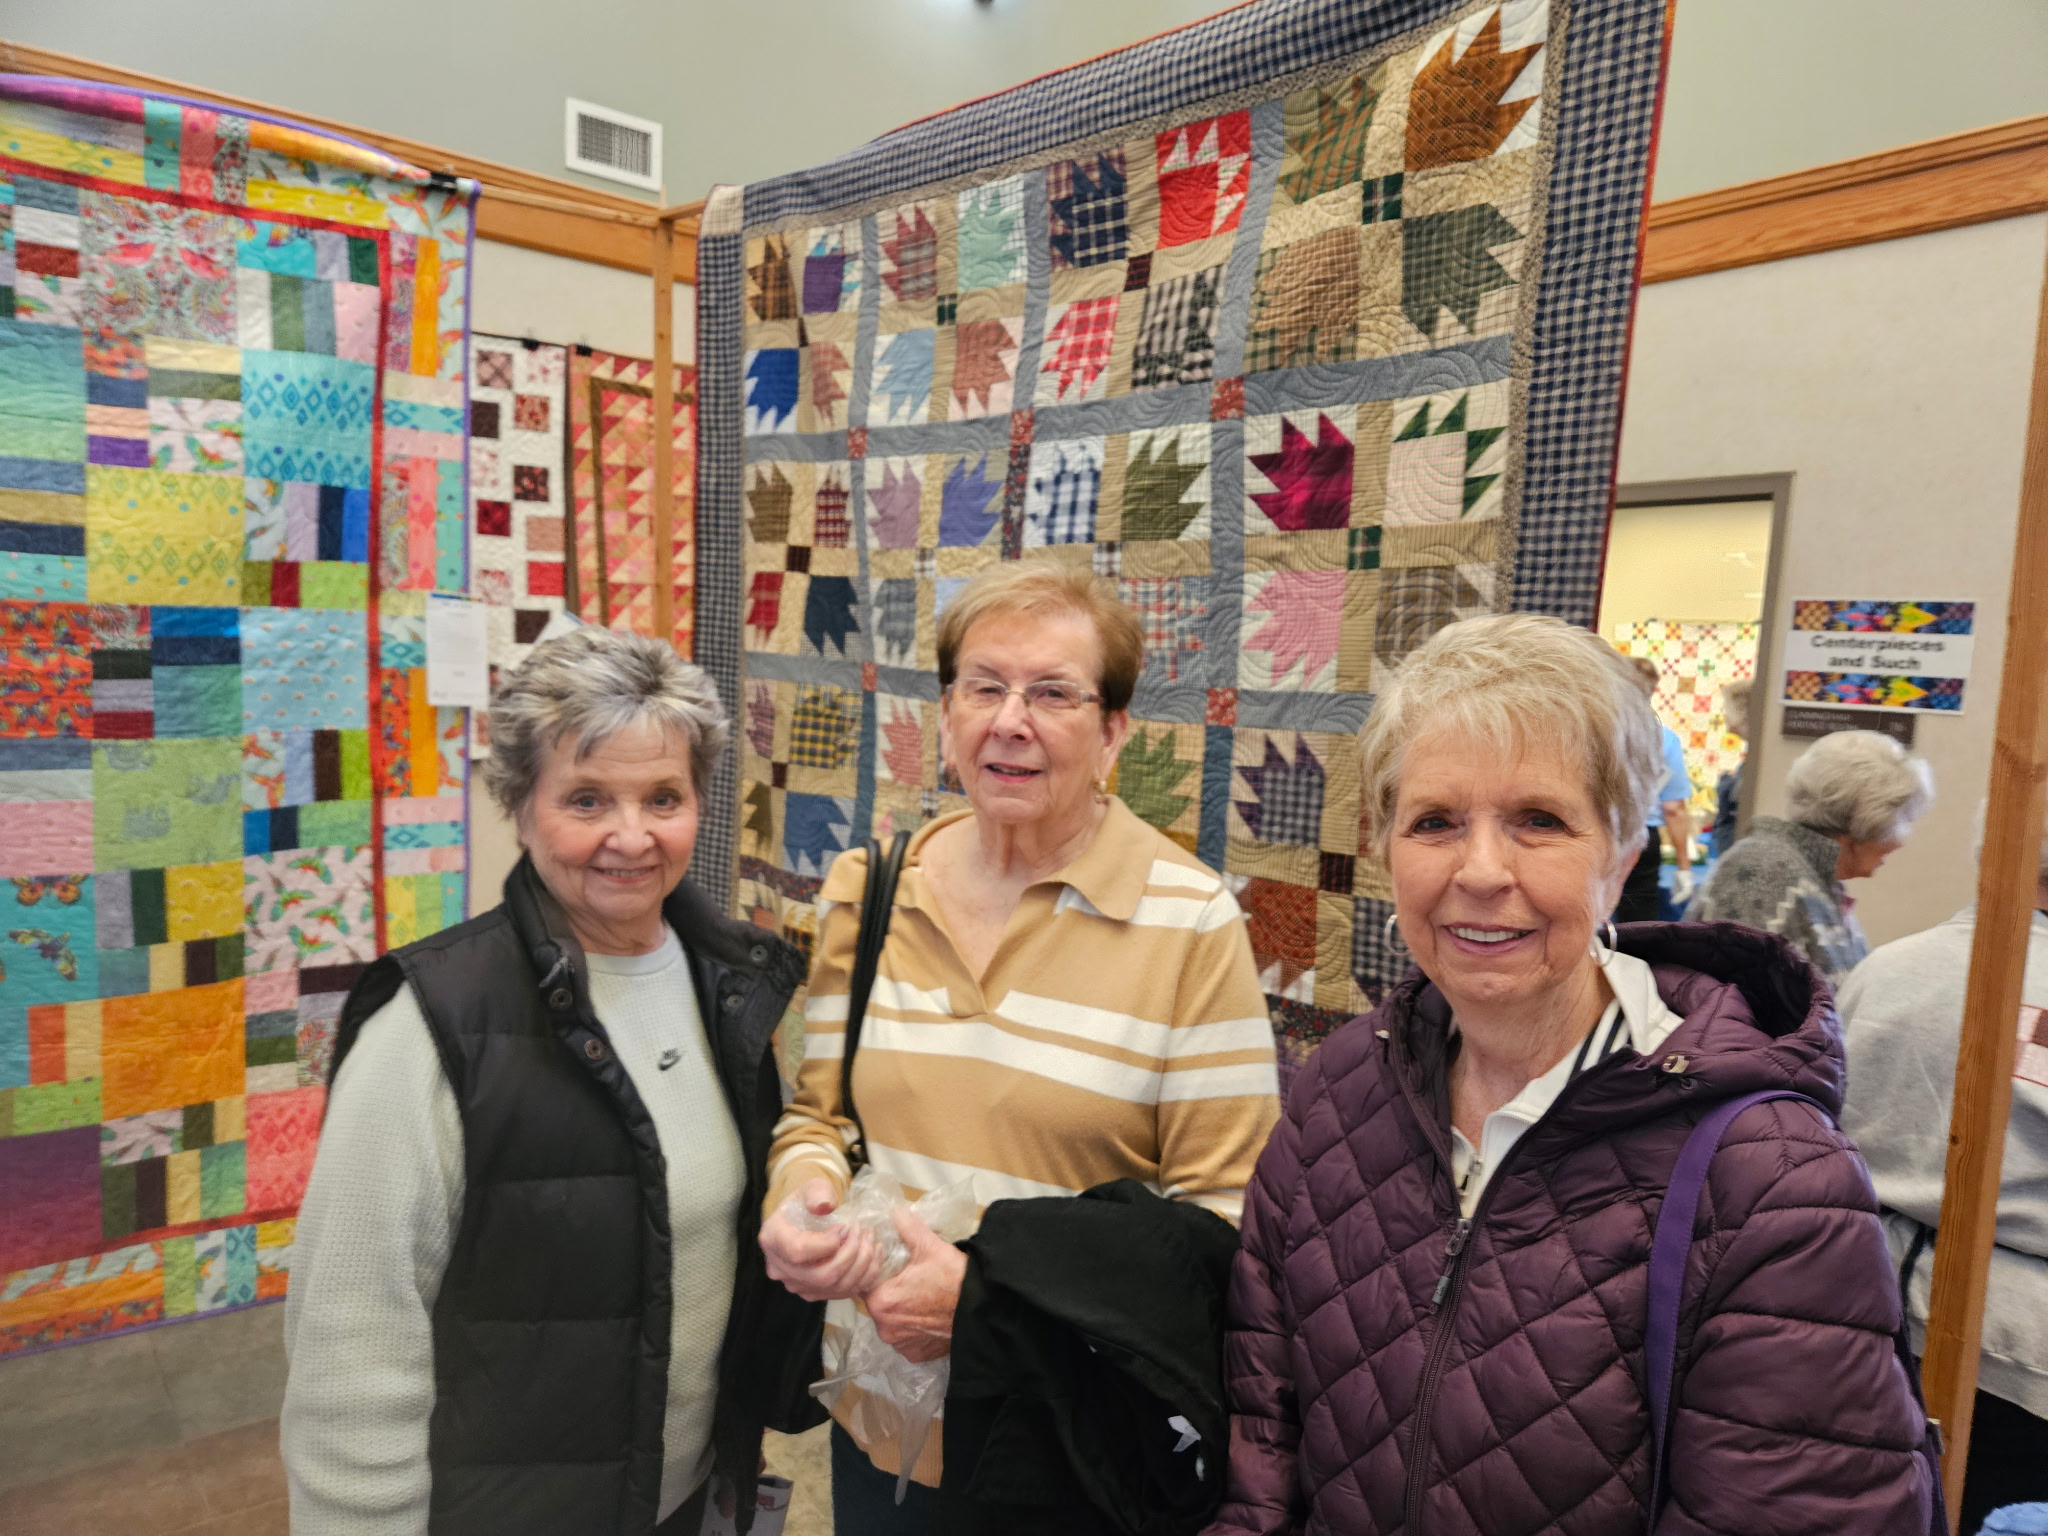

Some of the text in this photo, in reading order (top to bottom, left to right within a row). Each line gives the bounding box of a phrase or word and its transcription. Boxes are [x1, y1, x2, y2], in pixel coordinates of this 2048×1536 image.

[1811, 635, 1945, 652] Centerpieces
[1828, 656, 1921, 669] and Such
